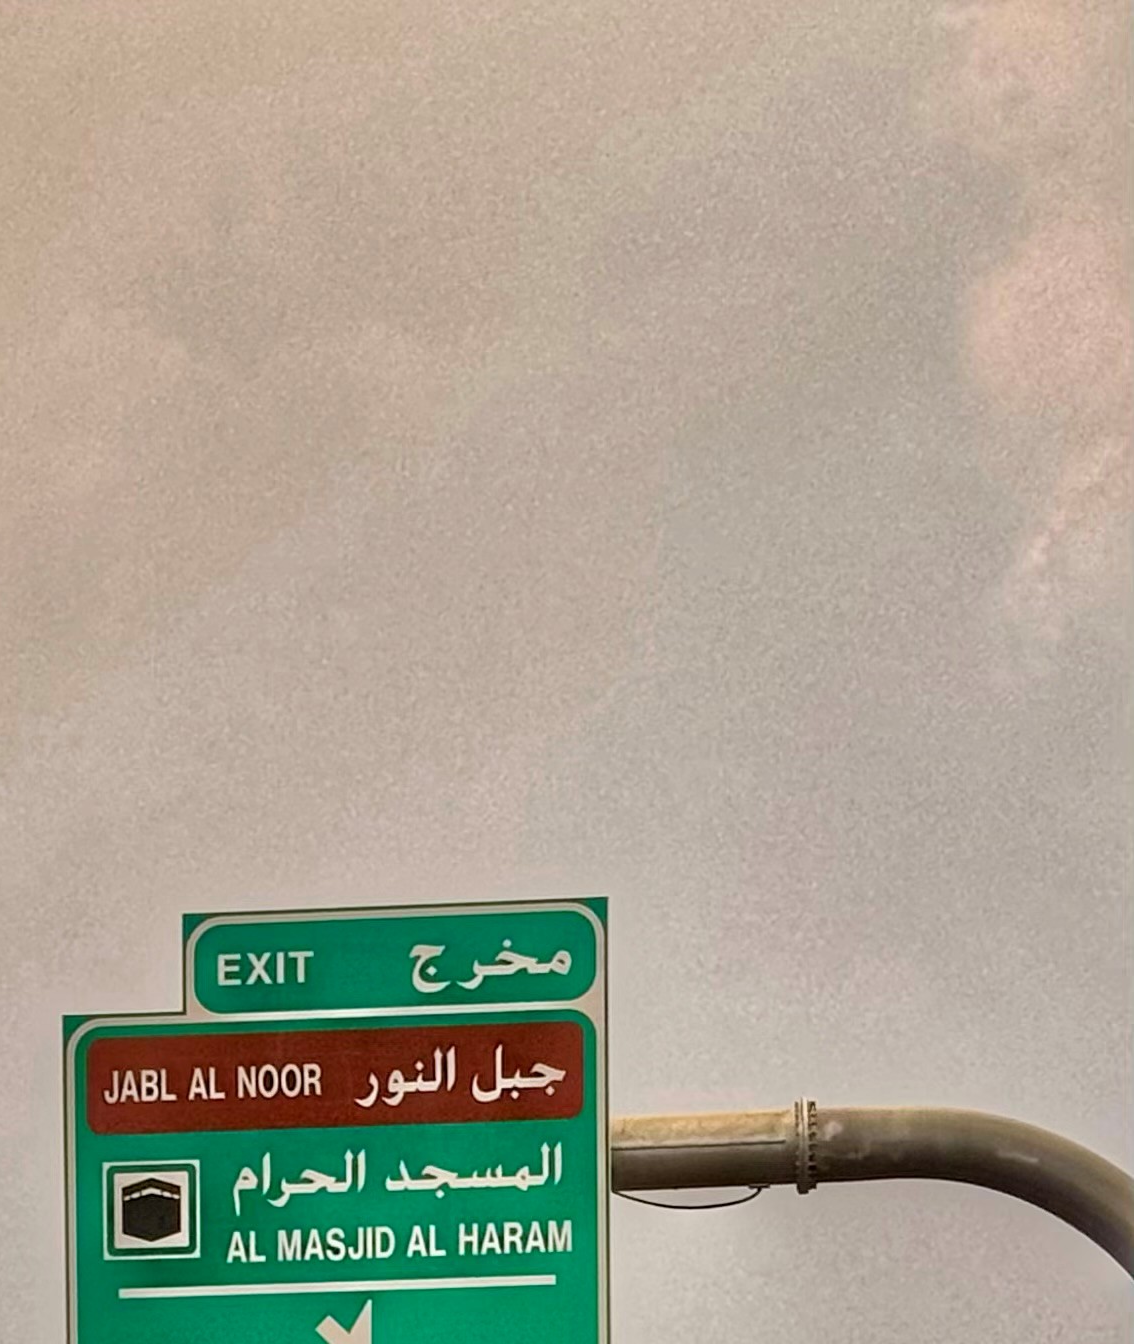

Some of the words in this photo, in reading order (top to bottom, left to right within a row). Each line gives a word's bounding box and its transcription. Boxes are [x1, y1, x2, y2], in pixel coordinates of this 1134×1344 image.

[217, 951, 314, 985] EXIT
[409, 939, 572, 993] مخرج
[104, 1068, 176, 1103] JABL
[189, 1067, 225, 1100] AL
[238, 1064, 322, 1098] NOOR
[355, 1046, 455, 1107] النور
[472, 1045, 566, 1102] جبل
[233, 1149, 365, 1216] الحرام
[385, 1142, 562, 1199] المسجد
[227, 1231, 266, 1263] AL
[278, 1227, 395, 1261] MASJID
[407, 1225, 446, 1257] AL
[458, 1220, 572, 1255] HARAM
